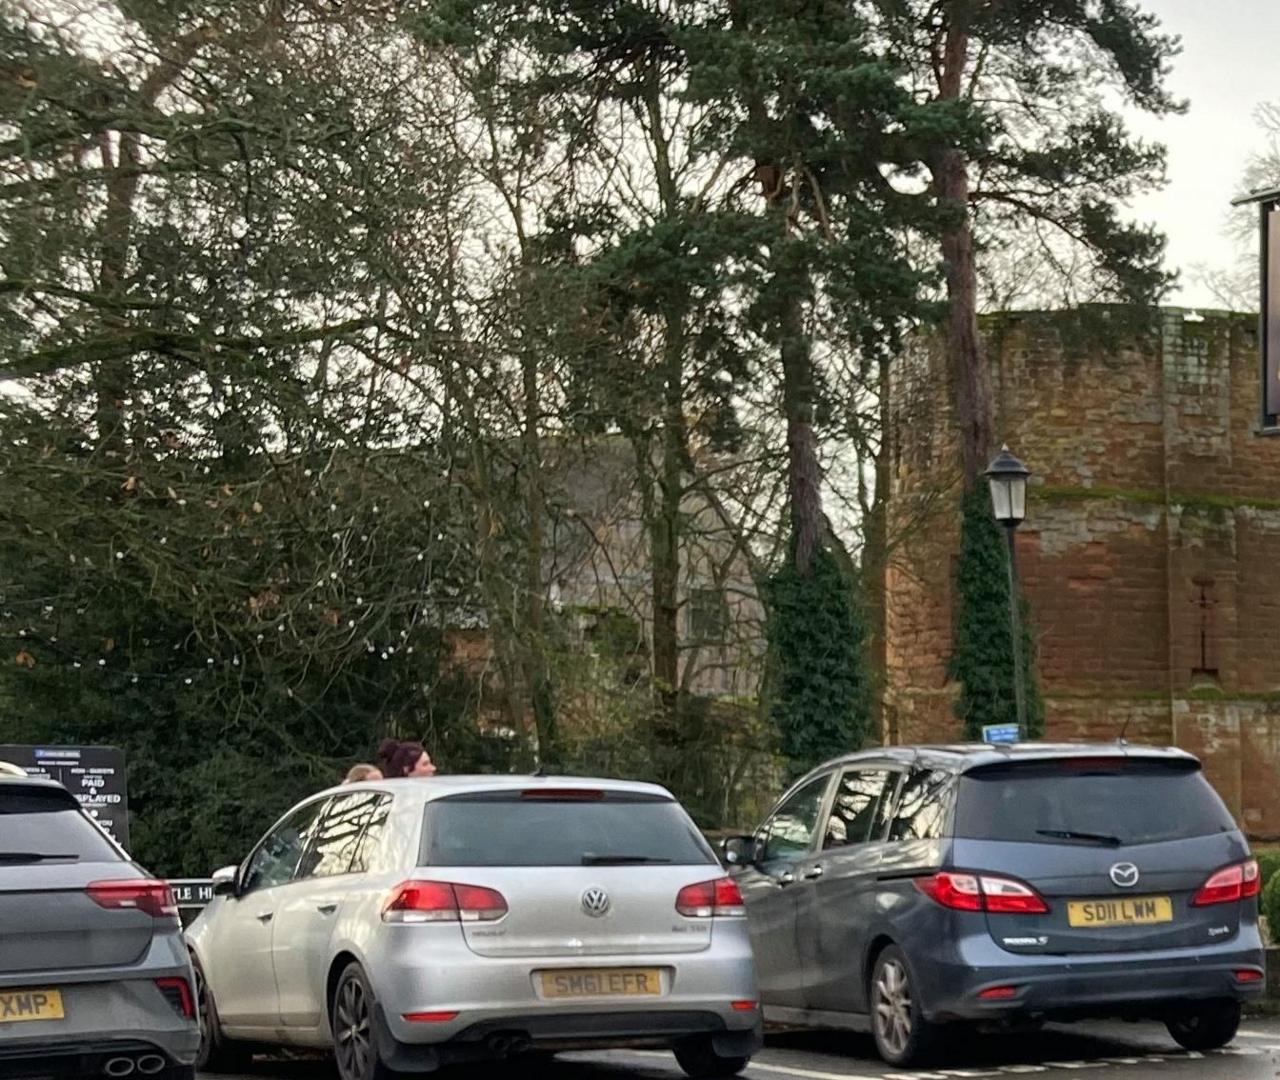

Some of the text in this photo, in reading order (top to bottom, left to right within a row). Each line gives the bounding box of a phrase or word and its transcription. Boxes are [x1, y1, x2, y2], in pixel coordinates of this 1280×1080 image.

[82, 779, 105, 787] PAID
[74, 794, 121, 803] SPLAYED
[199, 887, 212, 900] HI
[1121, 901, 1156, 919] LWM
[608, 972, 648, 992] EFR
[0, 994, 48, 1017] XMP
